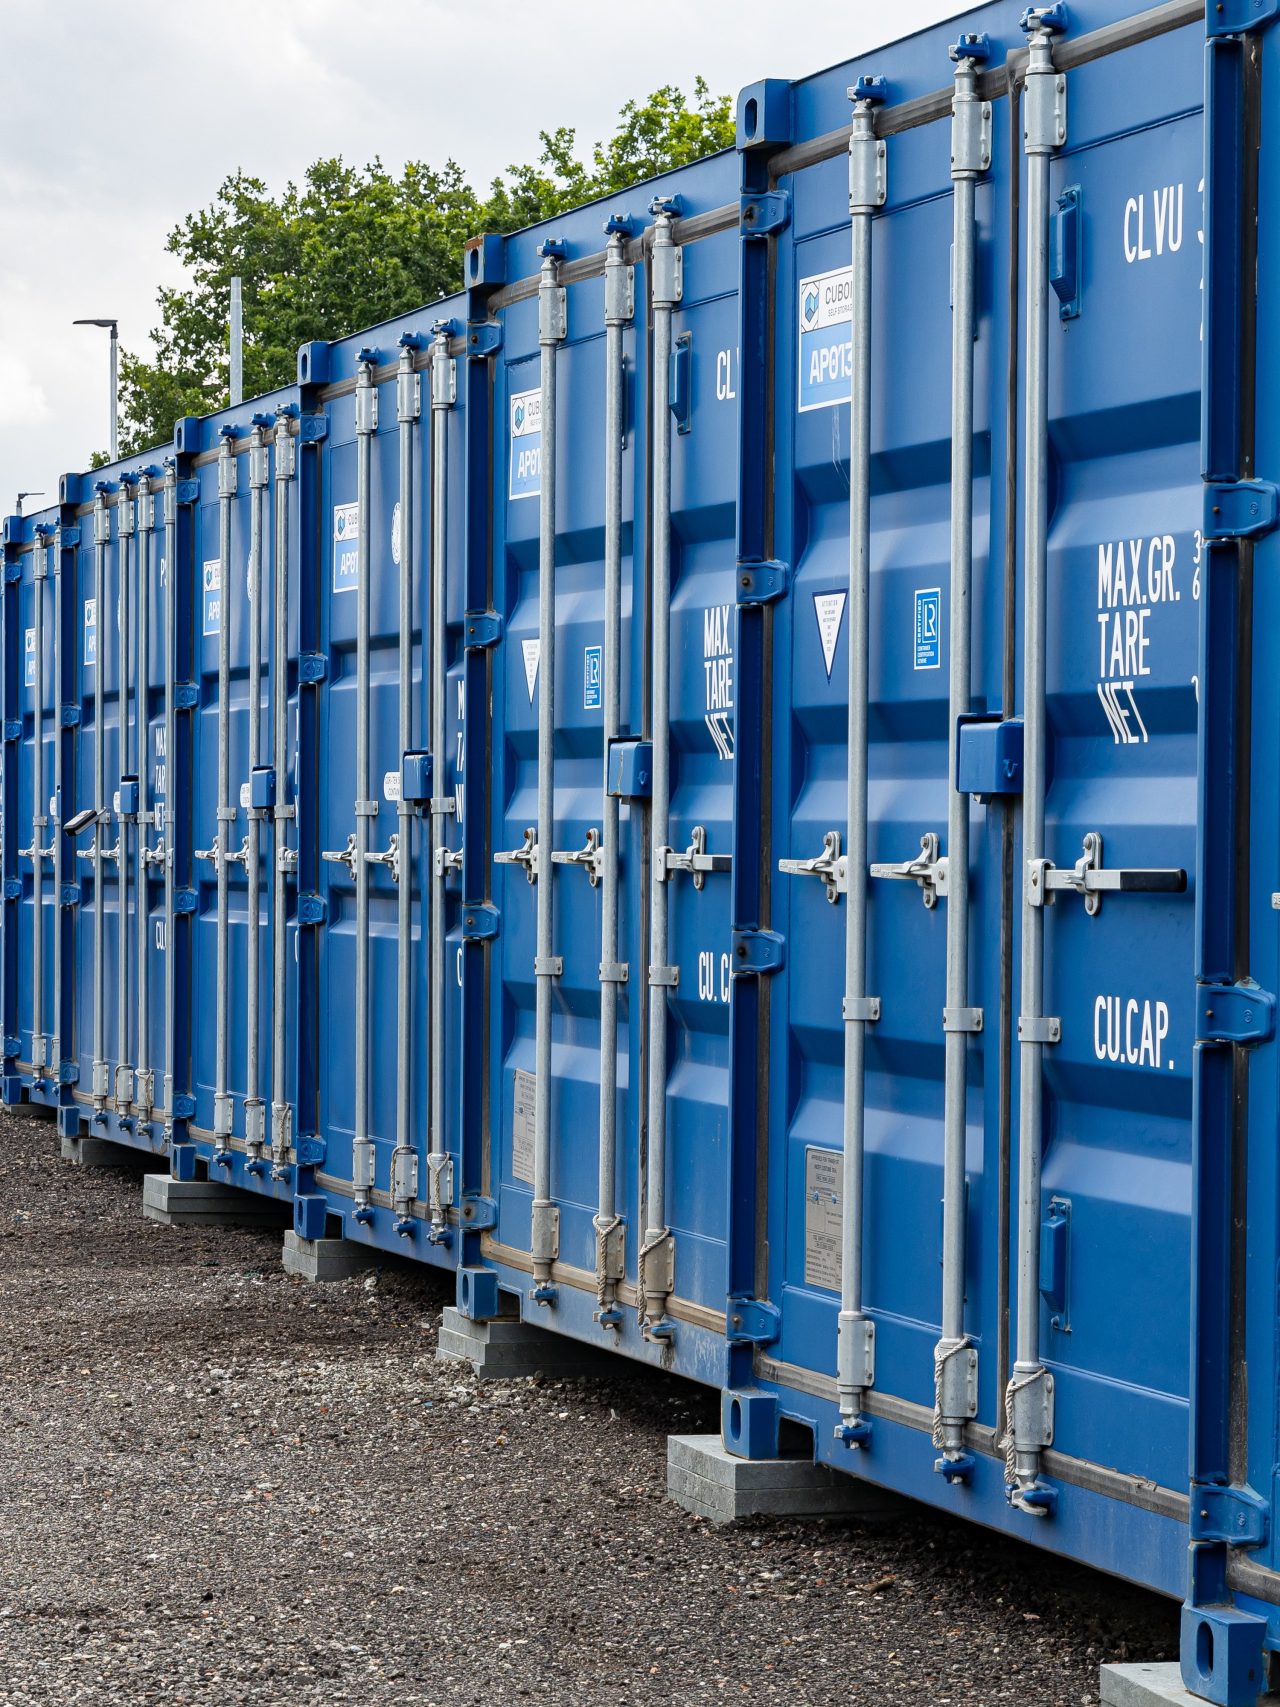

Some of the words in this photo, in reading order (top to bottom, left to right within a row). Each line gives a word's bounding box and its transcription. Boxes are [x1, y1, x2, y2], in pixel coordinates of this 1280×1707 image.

[1123, 184, 1183, 263] CLVU
[825, 281, 853, 304] CUBOI
[1098, 535, 1180, 609] MAX.GR.
[1098, 609, 1151, 678] TARE
[704, 658, 733, 711] TARE
[1097, 681, 1148, 744] NET
[1094, 995, 1174, 1070] CU.CAP.
